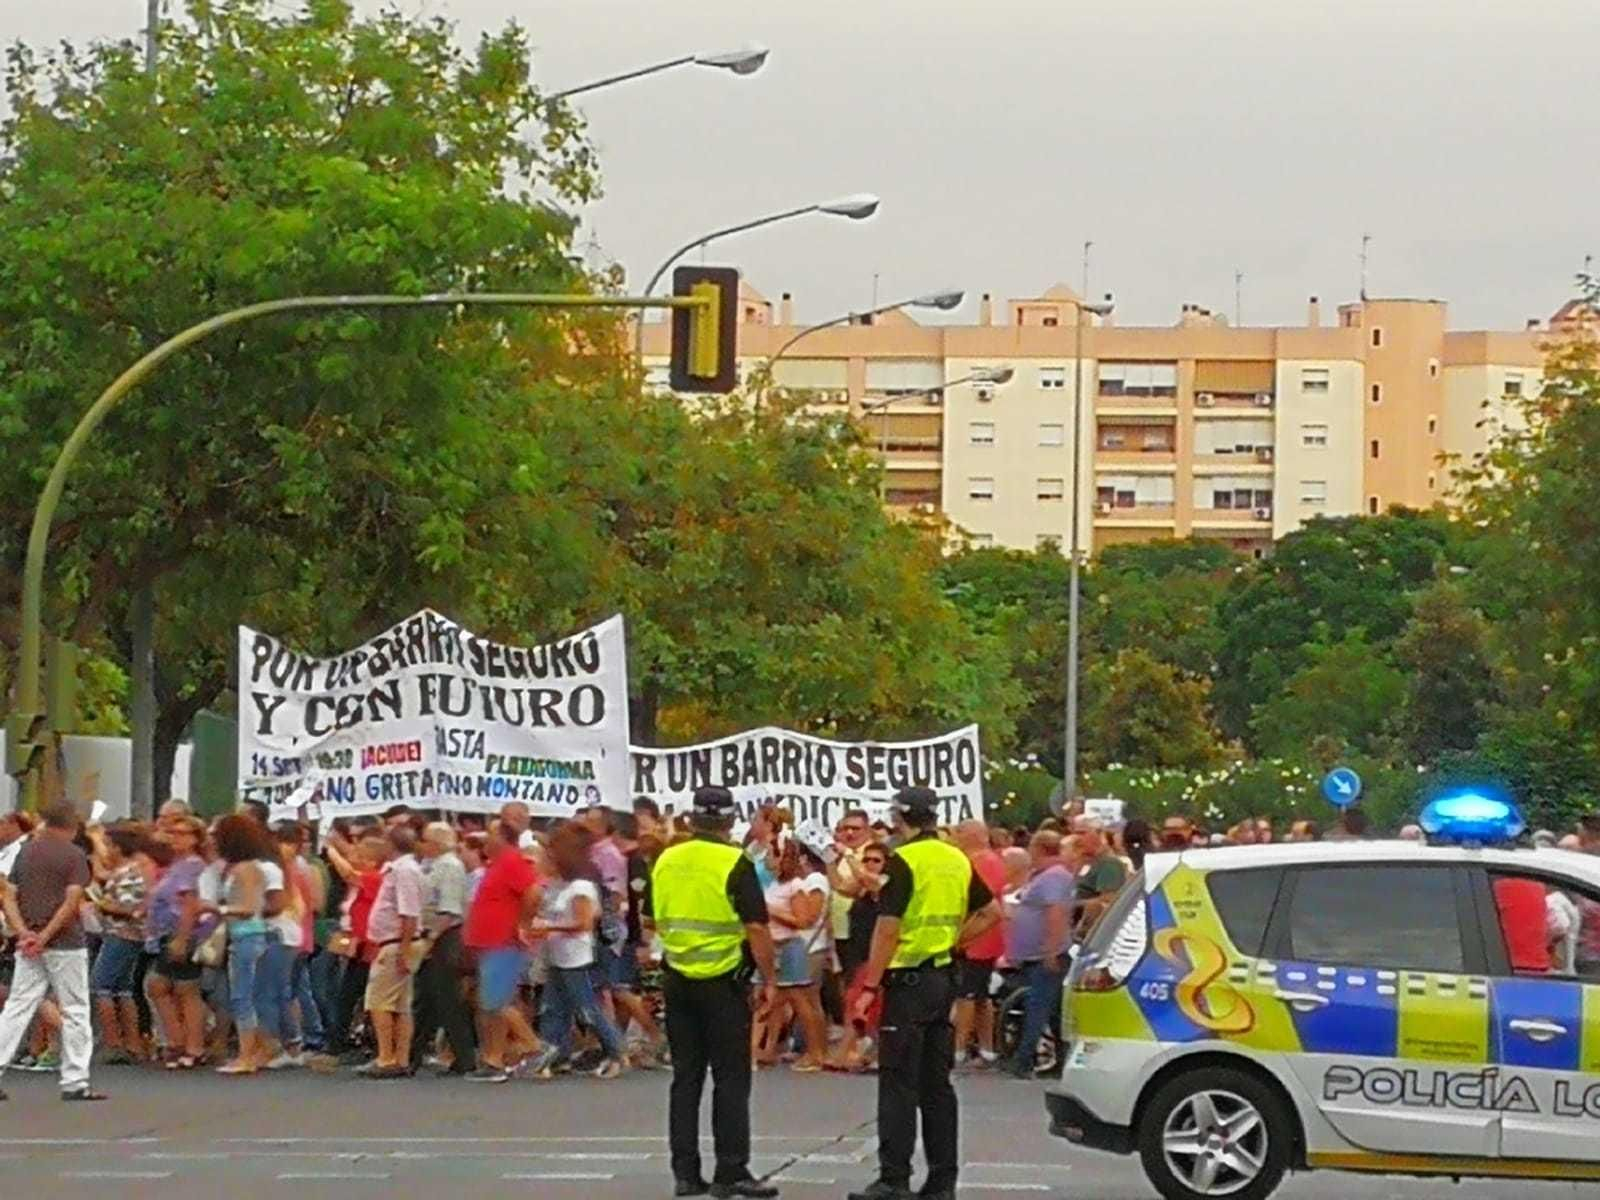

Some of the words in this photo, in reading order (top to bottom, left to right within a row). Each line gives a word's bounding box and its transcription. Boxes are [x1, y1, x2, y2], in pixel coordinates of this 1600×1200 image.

[366, 614, 465, 678] BARRO
[467, 632, 600, 680] SEGURO
[252, 692, 286, 735] Y
[304, 679, 402, 736] CON
[417, 673, 605, 727] FUTURO
[720, 737, 837, 788] BARRIO
[845, 738, 977, 791] SEGURO
[1140, 981, 1169, 1001] 405
[1323, 1064, 1541, 1114] POLICÍA
